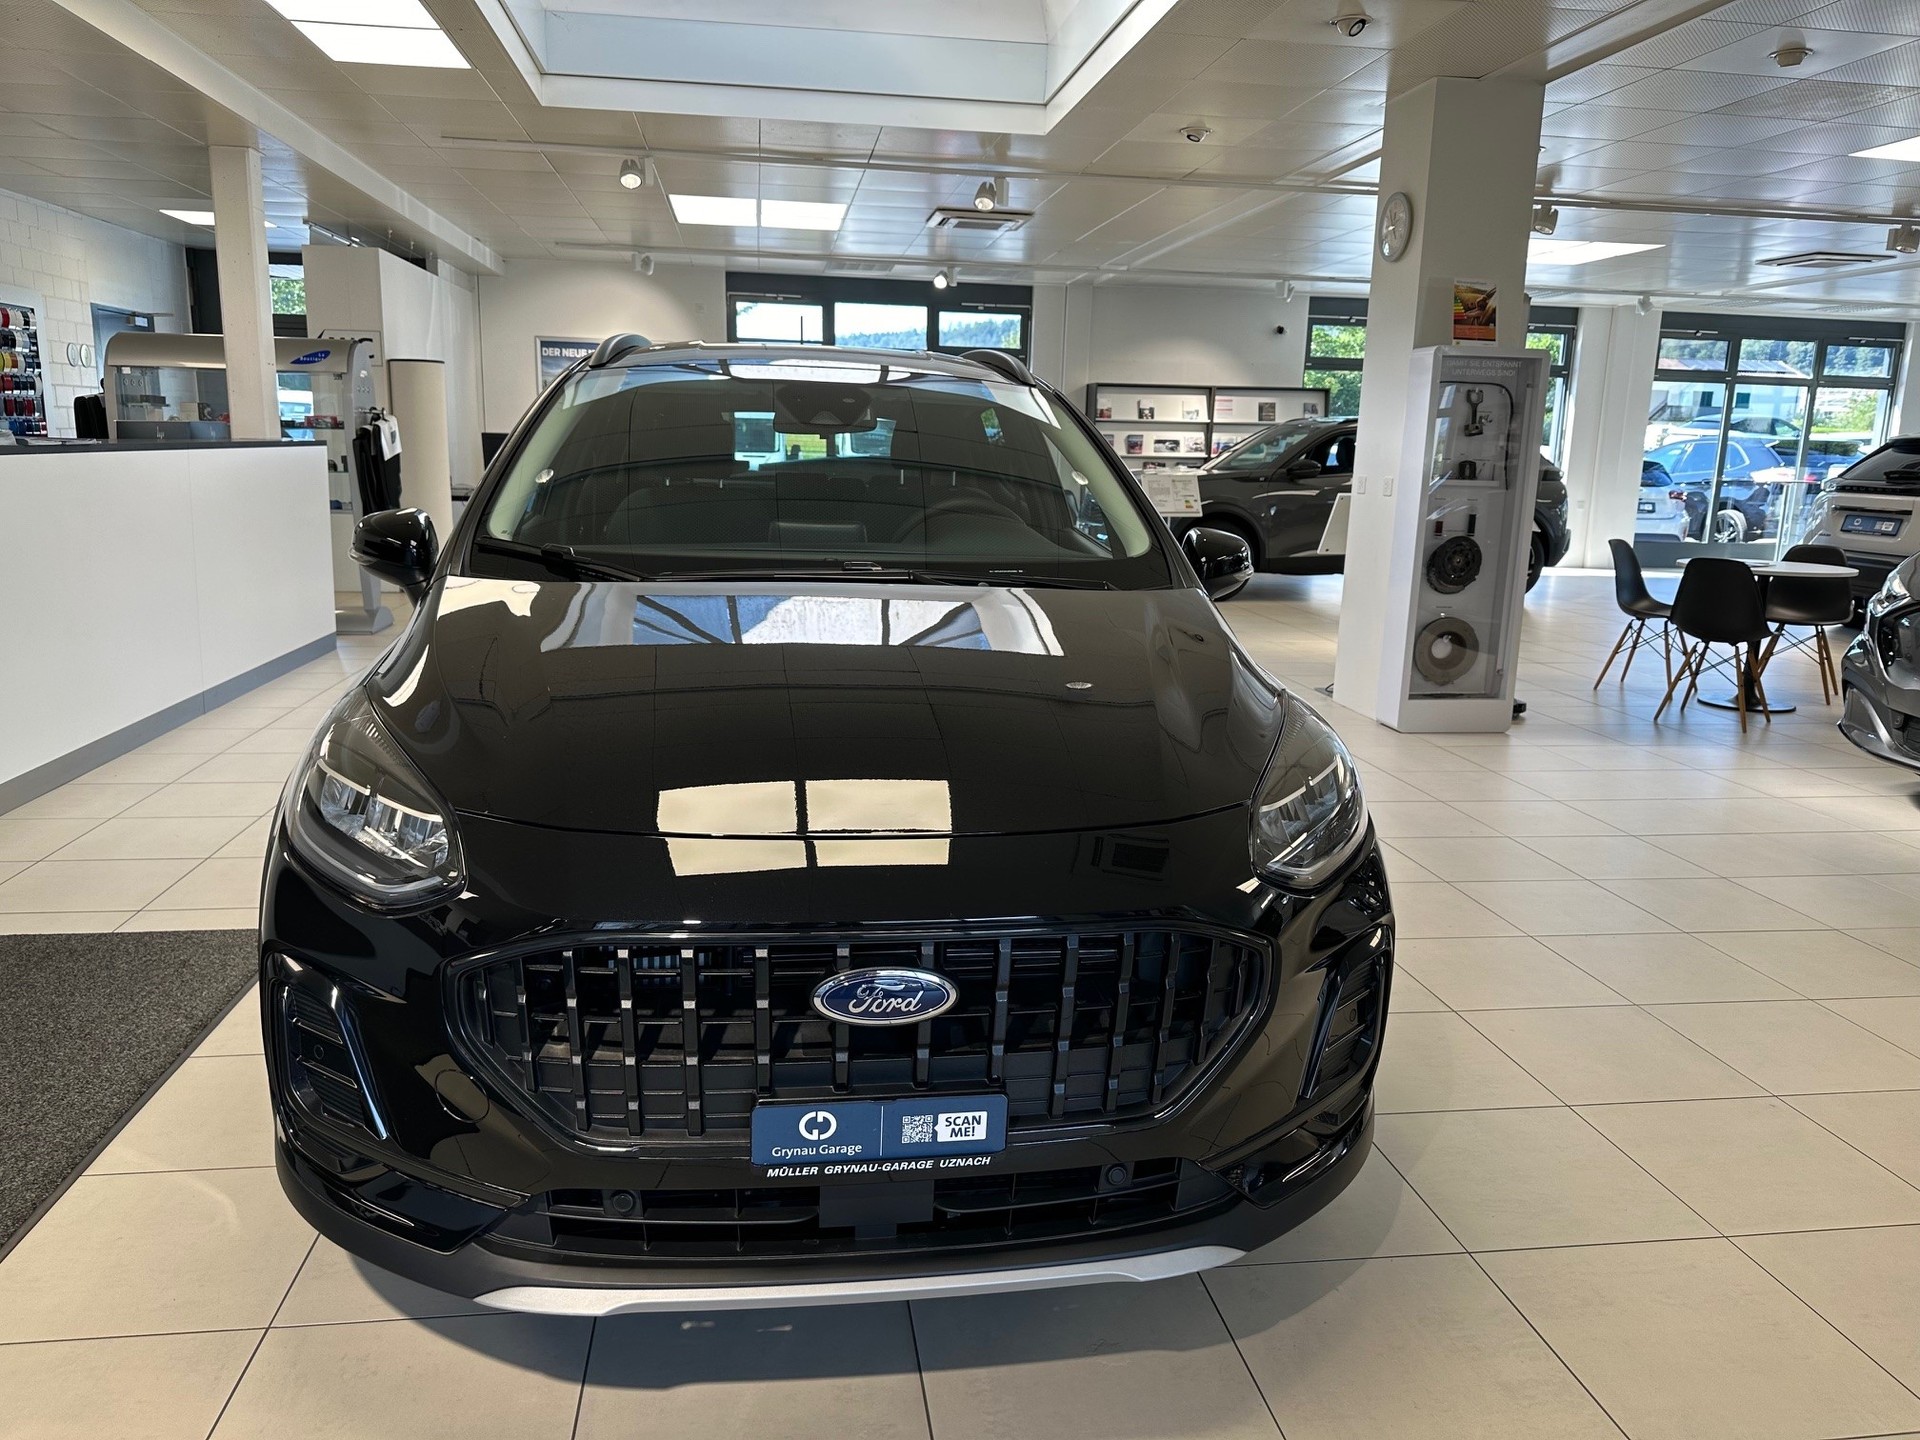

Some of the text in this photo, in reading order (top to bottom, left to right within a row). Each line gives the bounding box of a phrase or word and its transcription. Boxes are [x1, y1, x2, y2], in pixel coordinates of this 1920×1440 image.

[542, 347, 560, 356] DER
[1482, 360, 1522, 369] ENTSPANNT
[1452, 368, 1496, 377] UNTERWEGS
[849, 983, 924, 1013] Ford
[945, 1115, 982, 1127] SCAN
[949, 1126, 976, 1138] ME!
[772, 1144, 863, 1159] Grynau Garage
[766, 1156, 992, 1178] MÜLLER GRYNAU-GARAGE UZNACH
